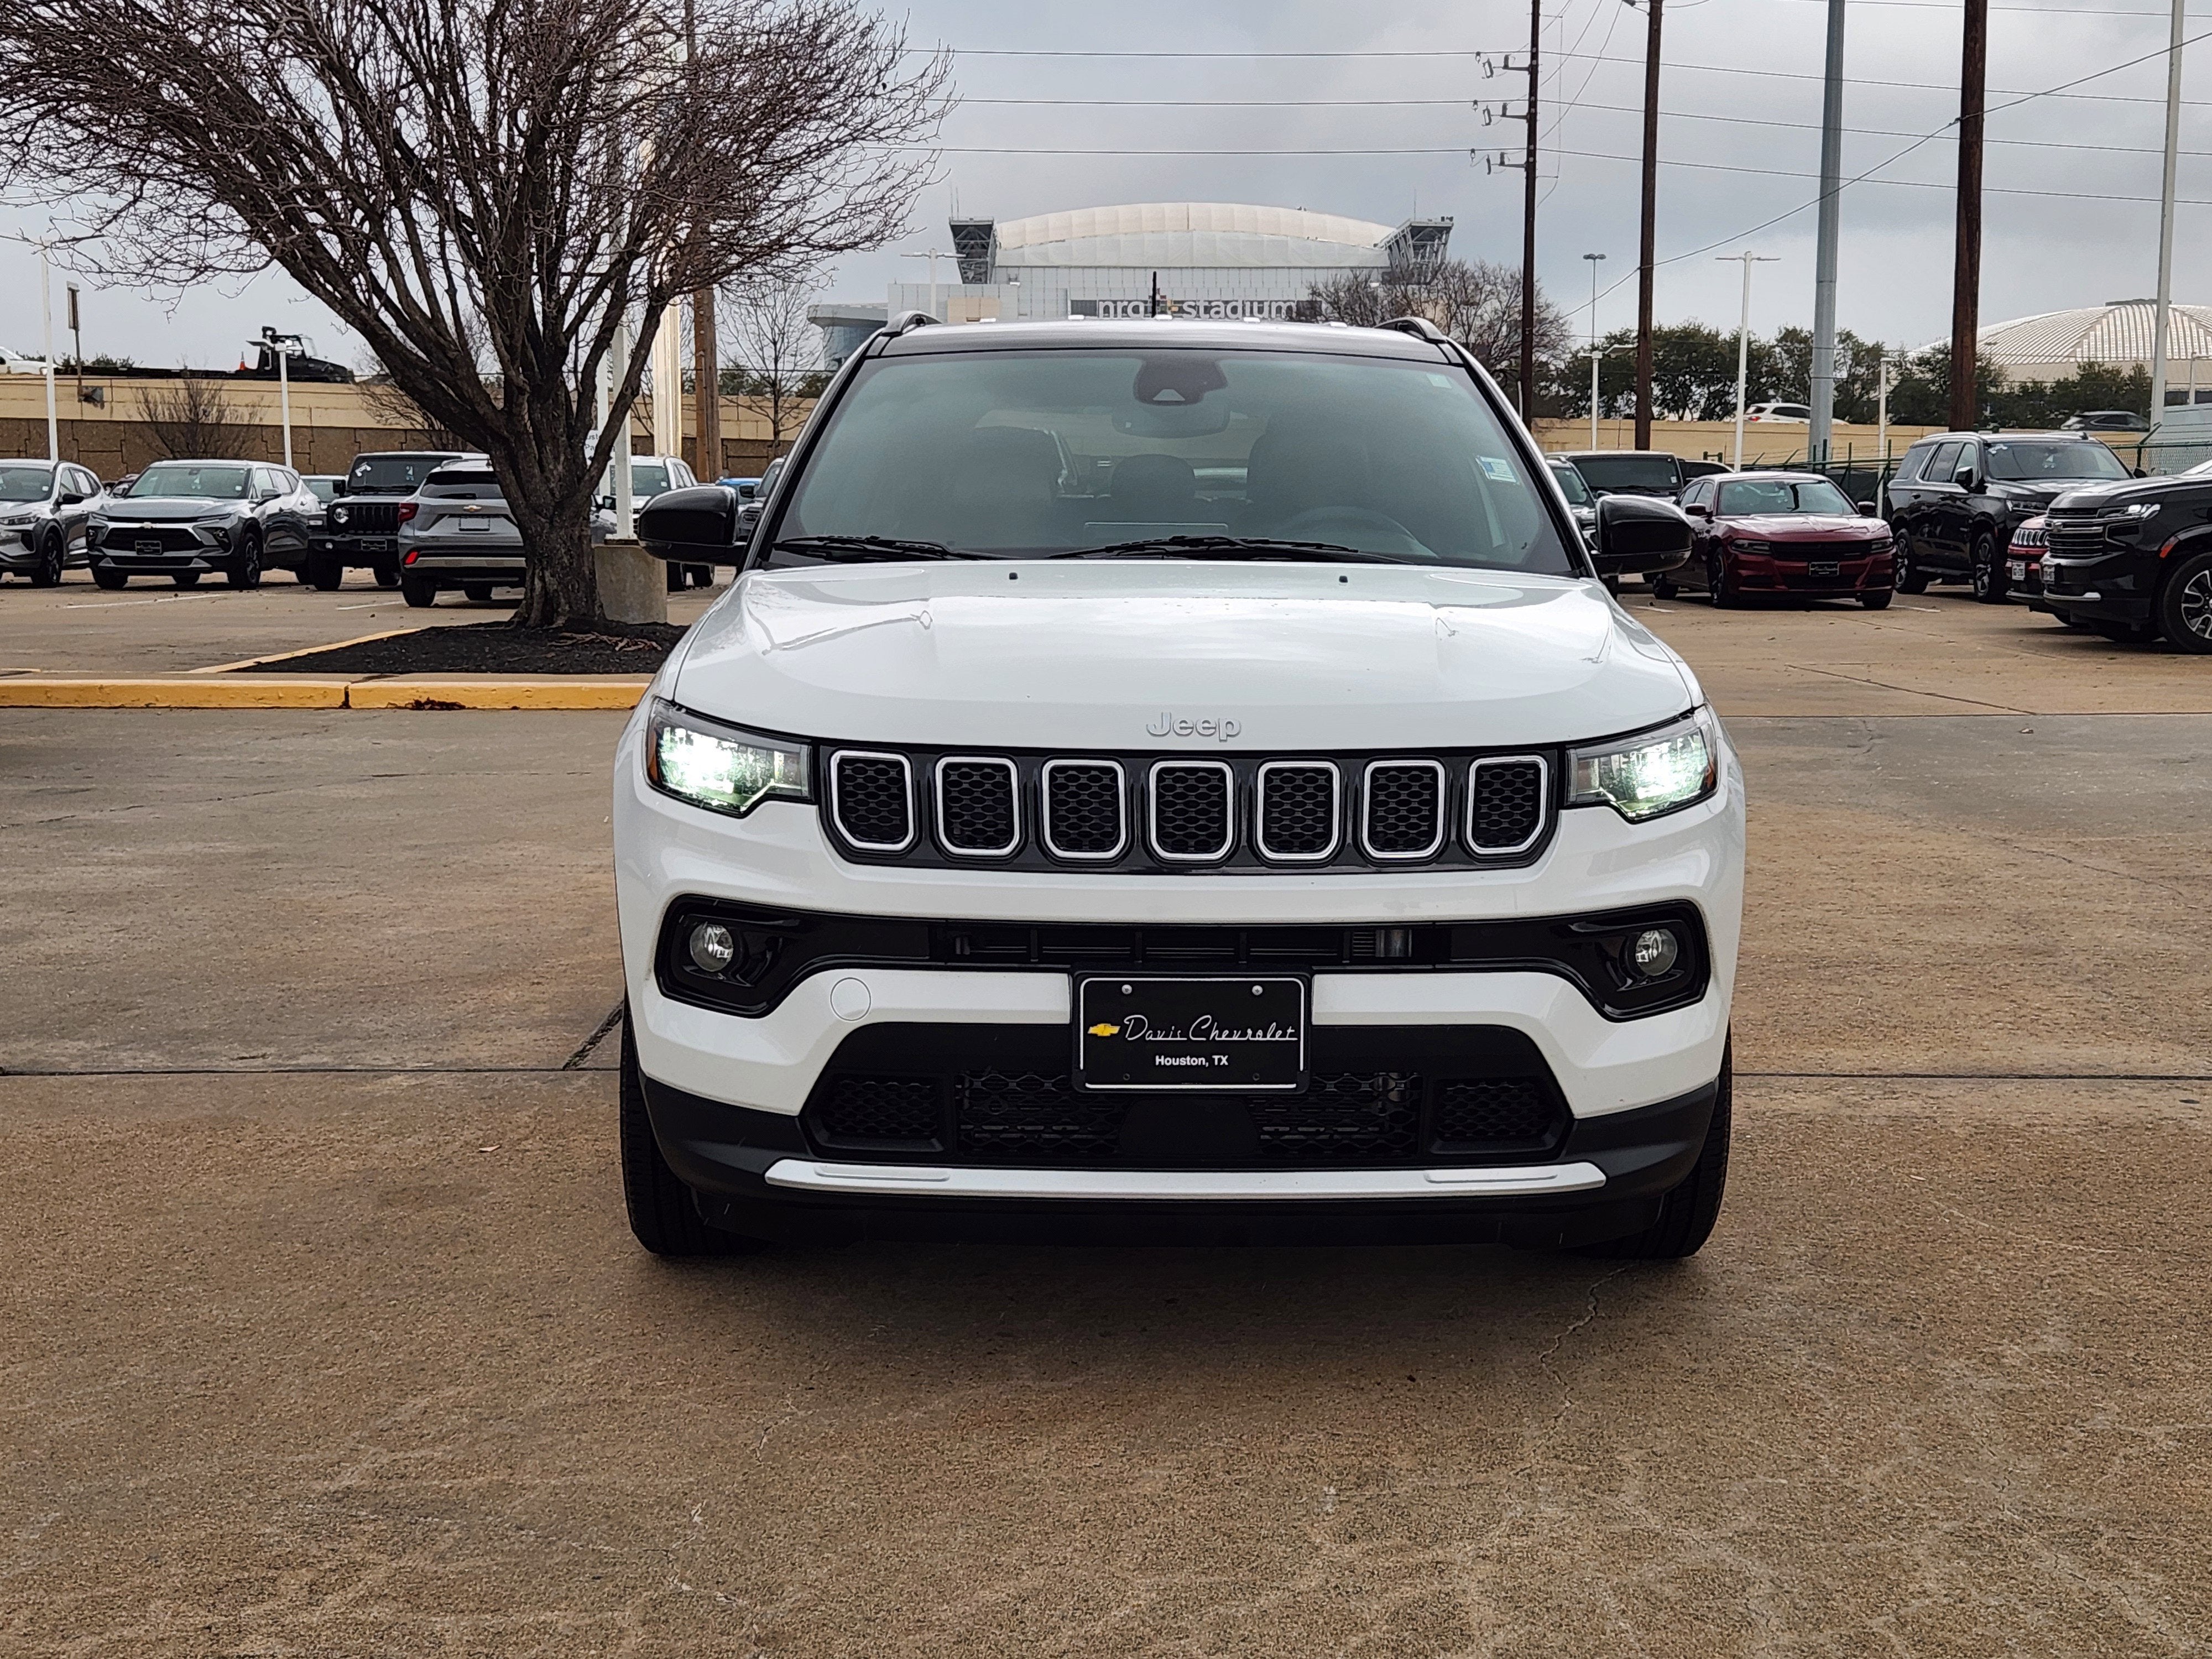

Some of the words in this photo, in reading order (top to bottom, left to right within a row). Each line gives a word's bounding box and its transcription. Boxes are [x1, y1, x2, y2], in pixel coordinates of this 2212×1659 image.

[1182, 299, 1296, 320] stadium
[1146, 711, 1241, 742] Jeep
[1123, 1014, 1187, 1041] Davis
[1189, 1014, 1298, 1041] Chevrolet
[1155, 1055, 1209, 1067] Houston,
[1212, 1055, 1229, 1066] TX
